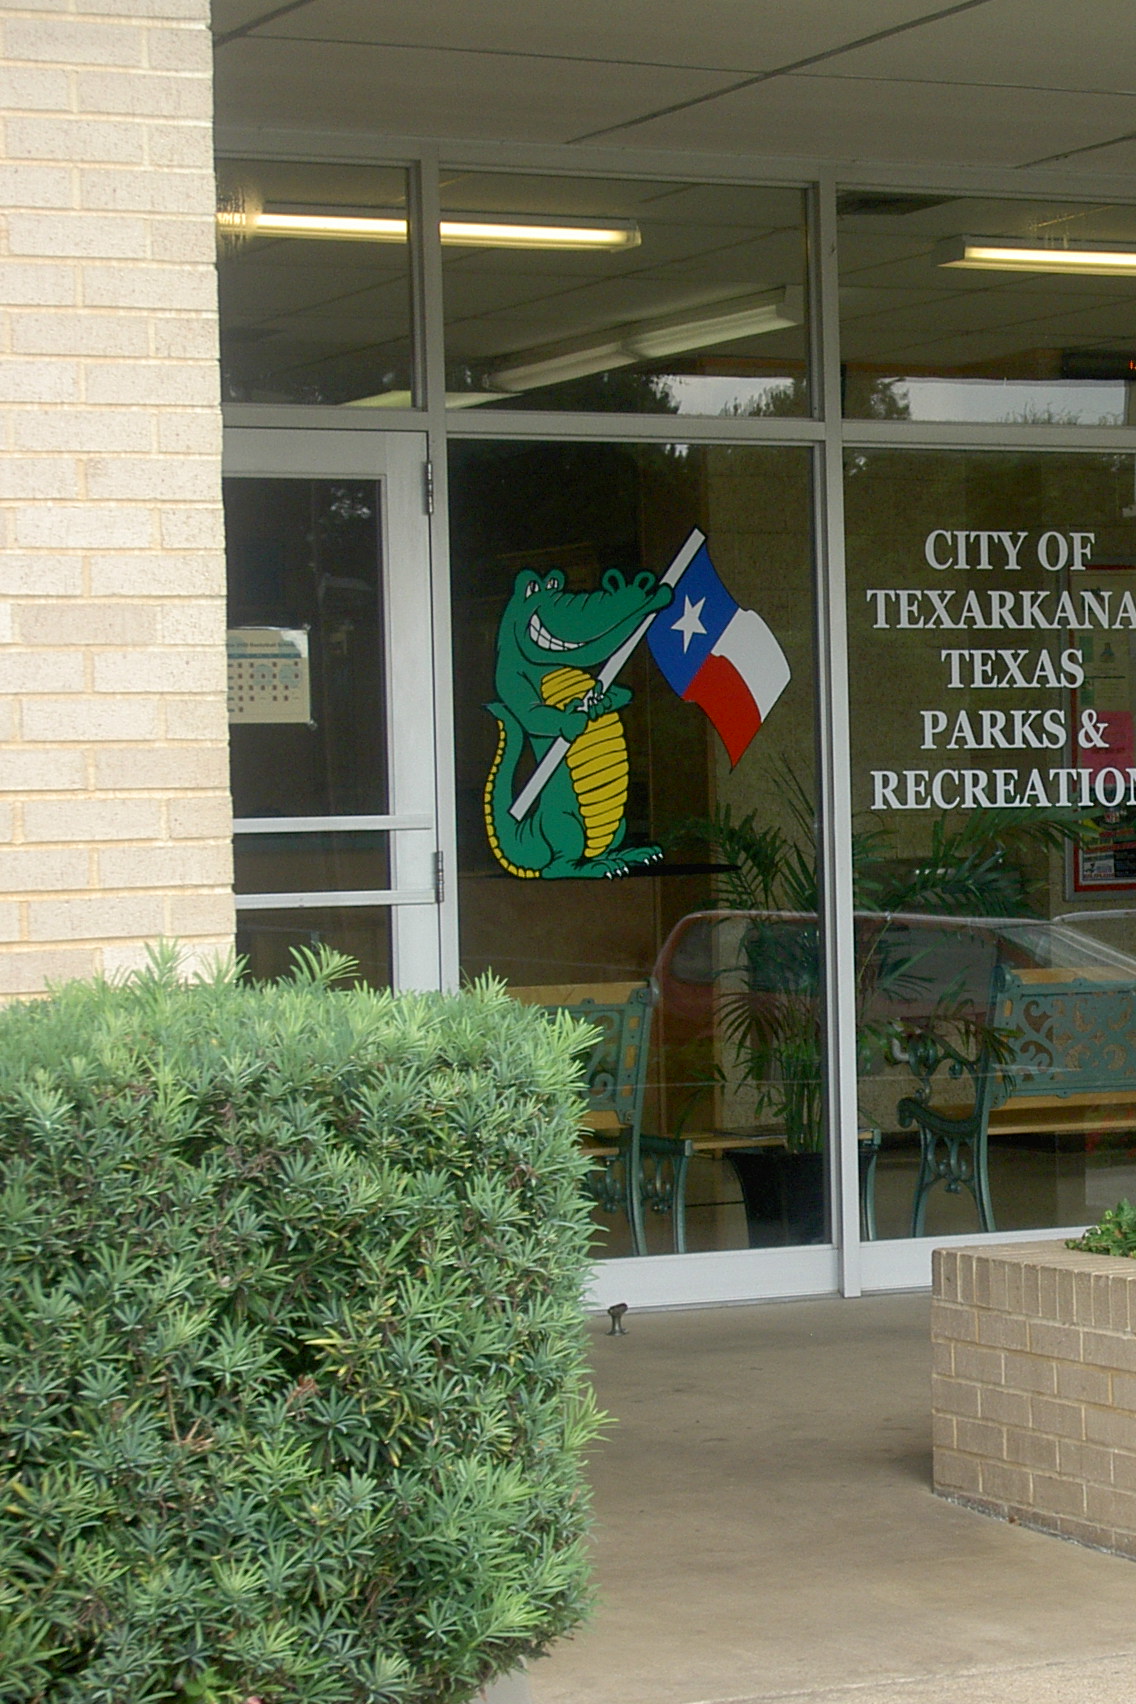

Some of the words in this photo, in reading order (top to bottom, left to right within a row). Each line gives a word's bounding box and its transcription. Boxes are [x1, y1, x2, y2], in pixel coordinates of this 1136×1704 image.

[926, 530, 1028, 569] CITY
[1038, 532, 1094, 570] OF
[941, 649, 1084, 688] TEXAS
[920, 710, 1066, 749] PARKS
[1078, 709, 1109, 748] &
